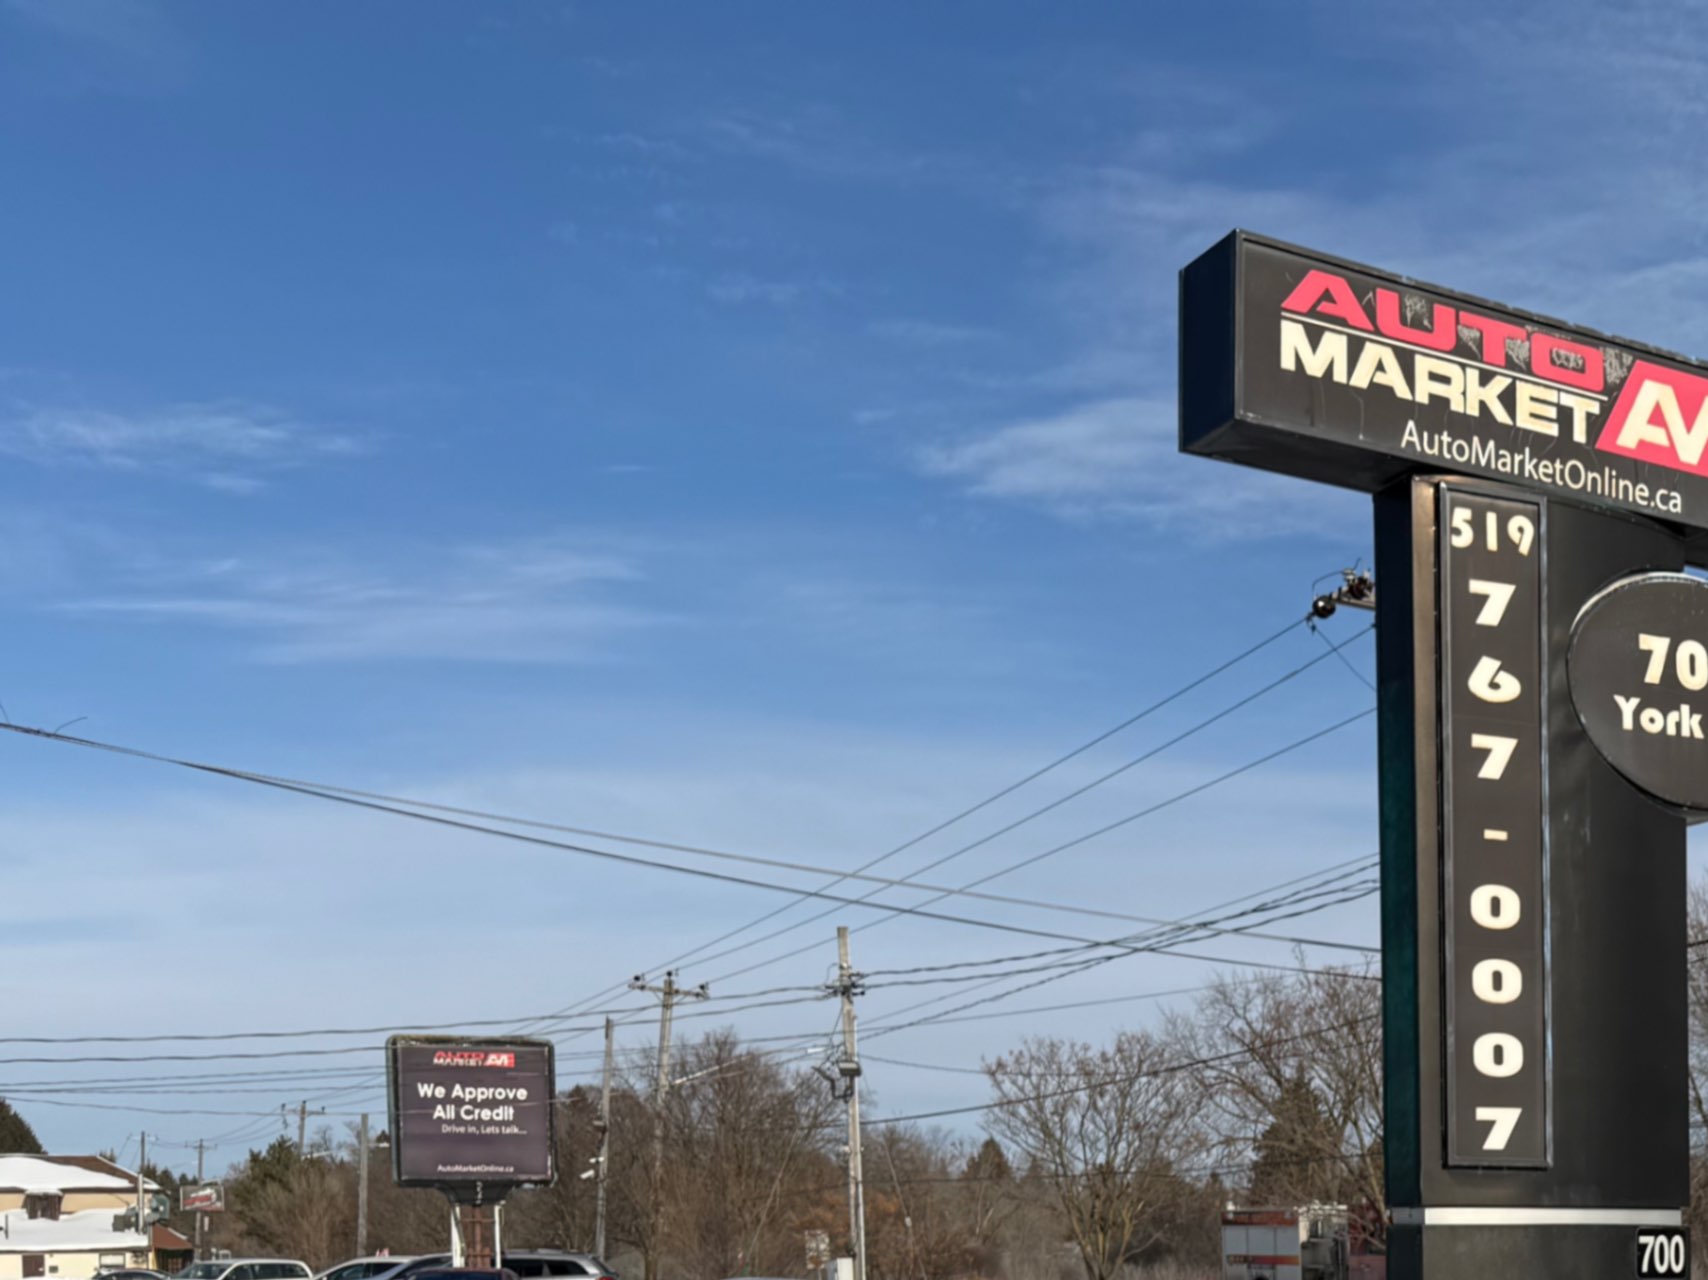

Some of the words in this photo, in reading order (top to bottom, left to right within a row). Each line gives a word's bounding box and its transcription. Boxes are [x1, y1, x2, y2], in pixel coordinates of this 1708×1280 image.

[1280, 269, 1605, 391] AUTO
[1280, 318, 1601, 444] MARKET
[1400, 419, 1683, 514] AutoMarketOnline.ca
[1451, 506, 1535, 557] 519
[1613, 694, 1705, 739] York
[417, 1082, 446, 1099] We
[451, 1083, 528, 1103] Approve
[433, 1104, 456, 1120] All
[460, 1104, 515, 1121] Credit
[442, 1123, 466, 1134] Drive
[481, 1125, 500, 1135] Lets
[437, 1163, 515, 1173] AutoMarketOnline.ca
[1638, 1234, 1685, 1274] 700
